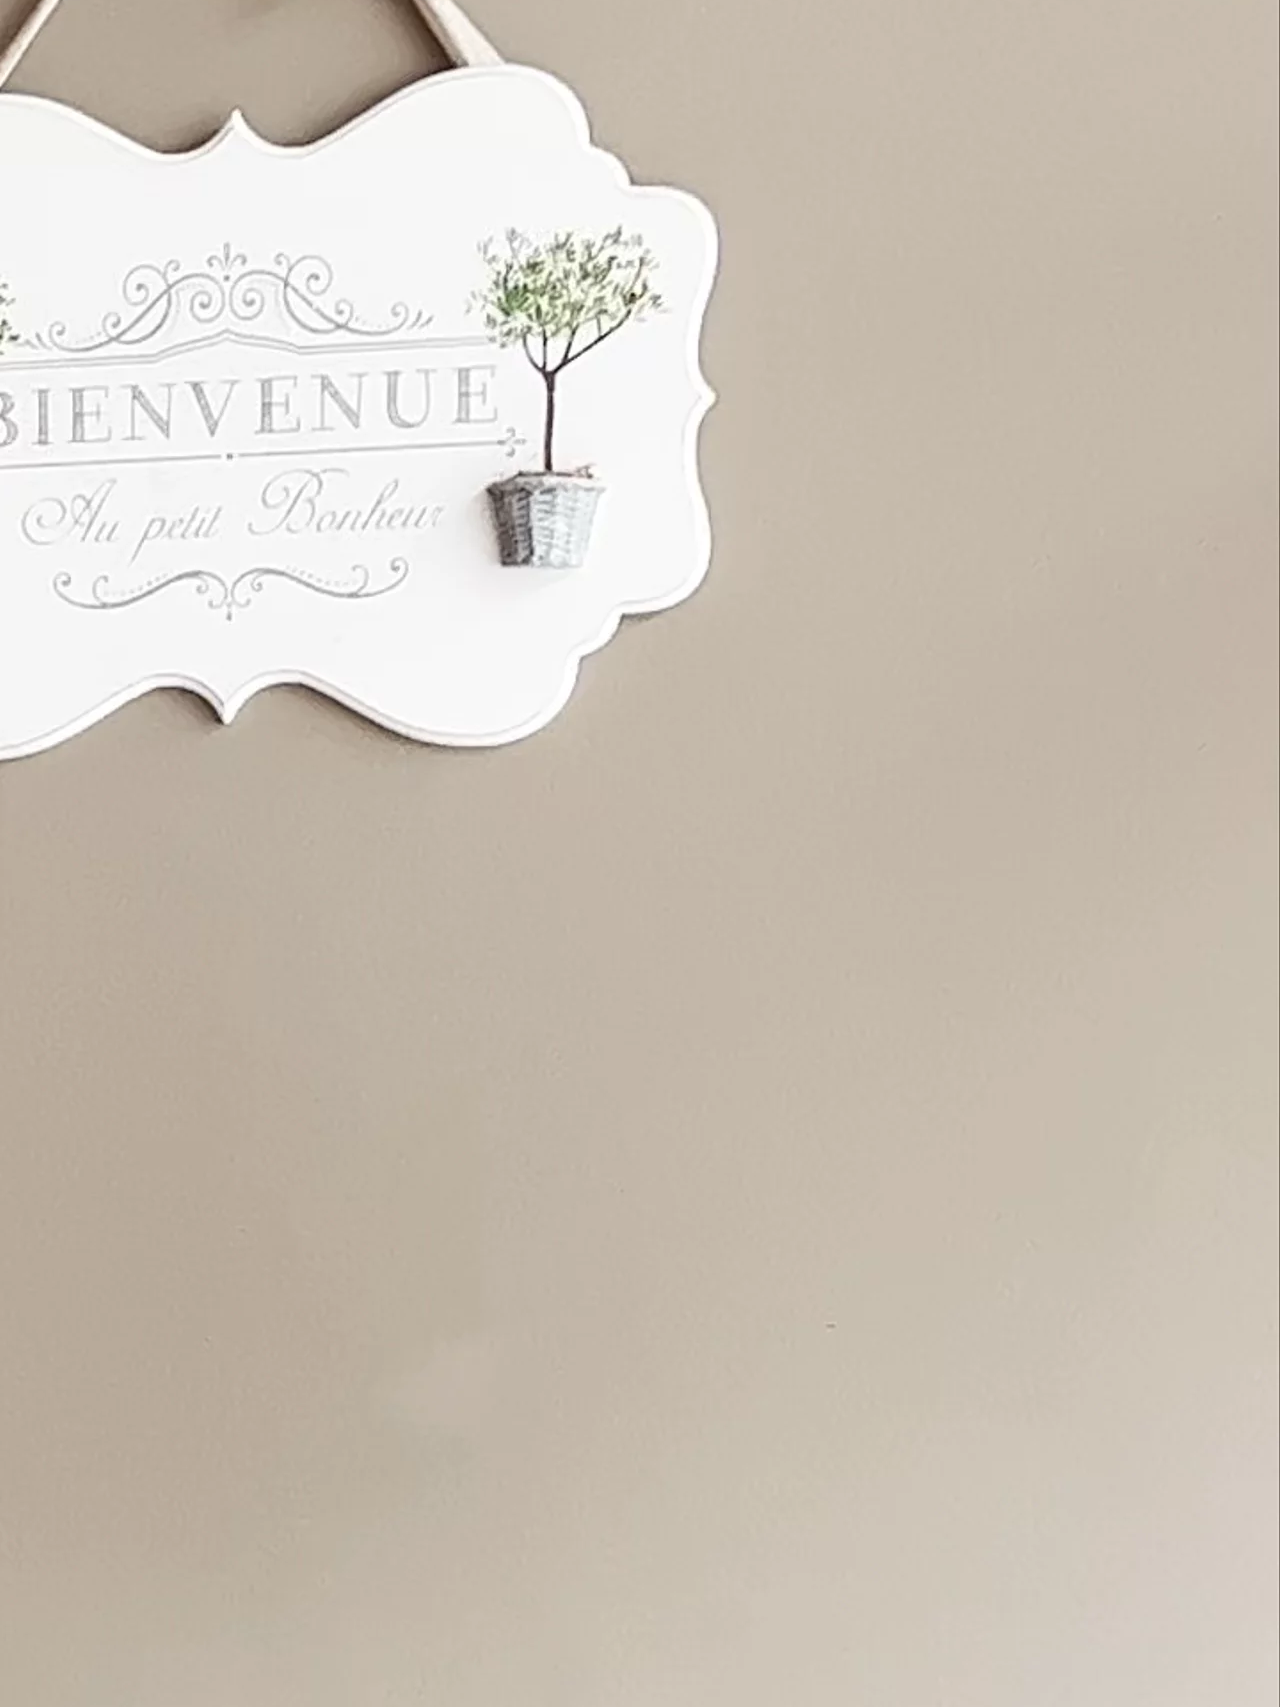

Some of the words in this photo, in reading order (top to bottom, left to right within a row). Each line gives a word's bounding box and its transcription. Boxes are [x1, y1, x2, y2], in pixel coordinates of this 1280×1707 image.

[21, 479, 119, 547] Au
[130, 503, 225, 565] petit
[248, 468, 446, 536] Bonheur
